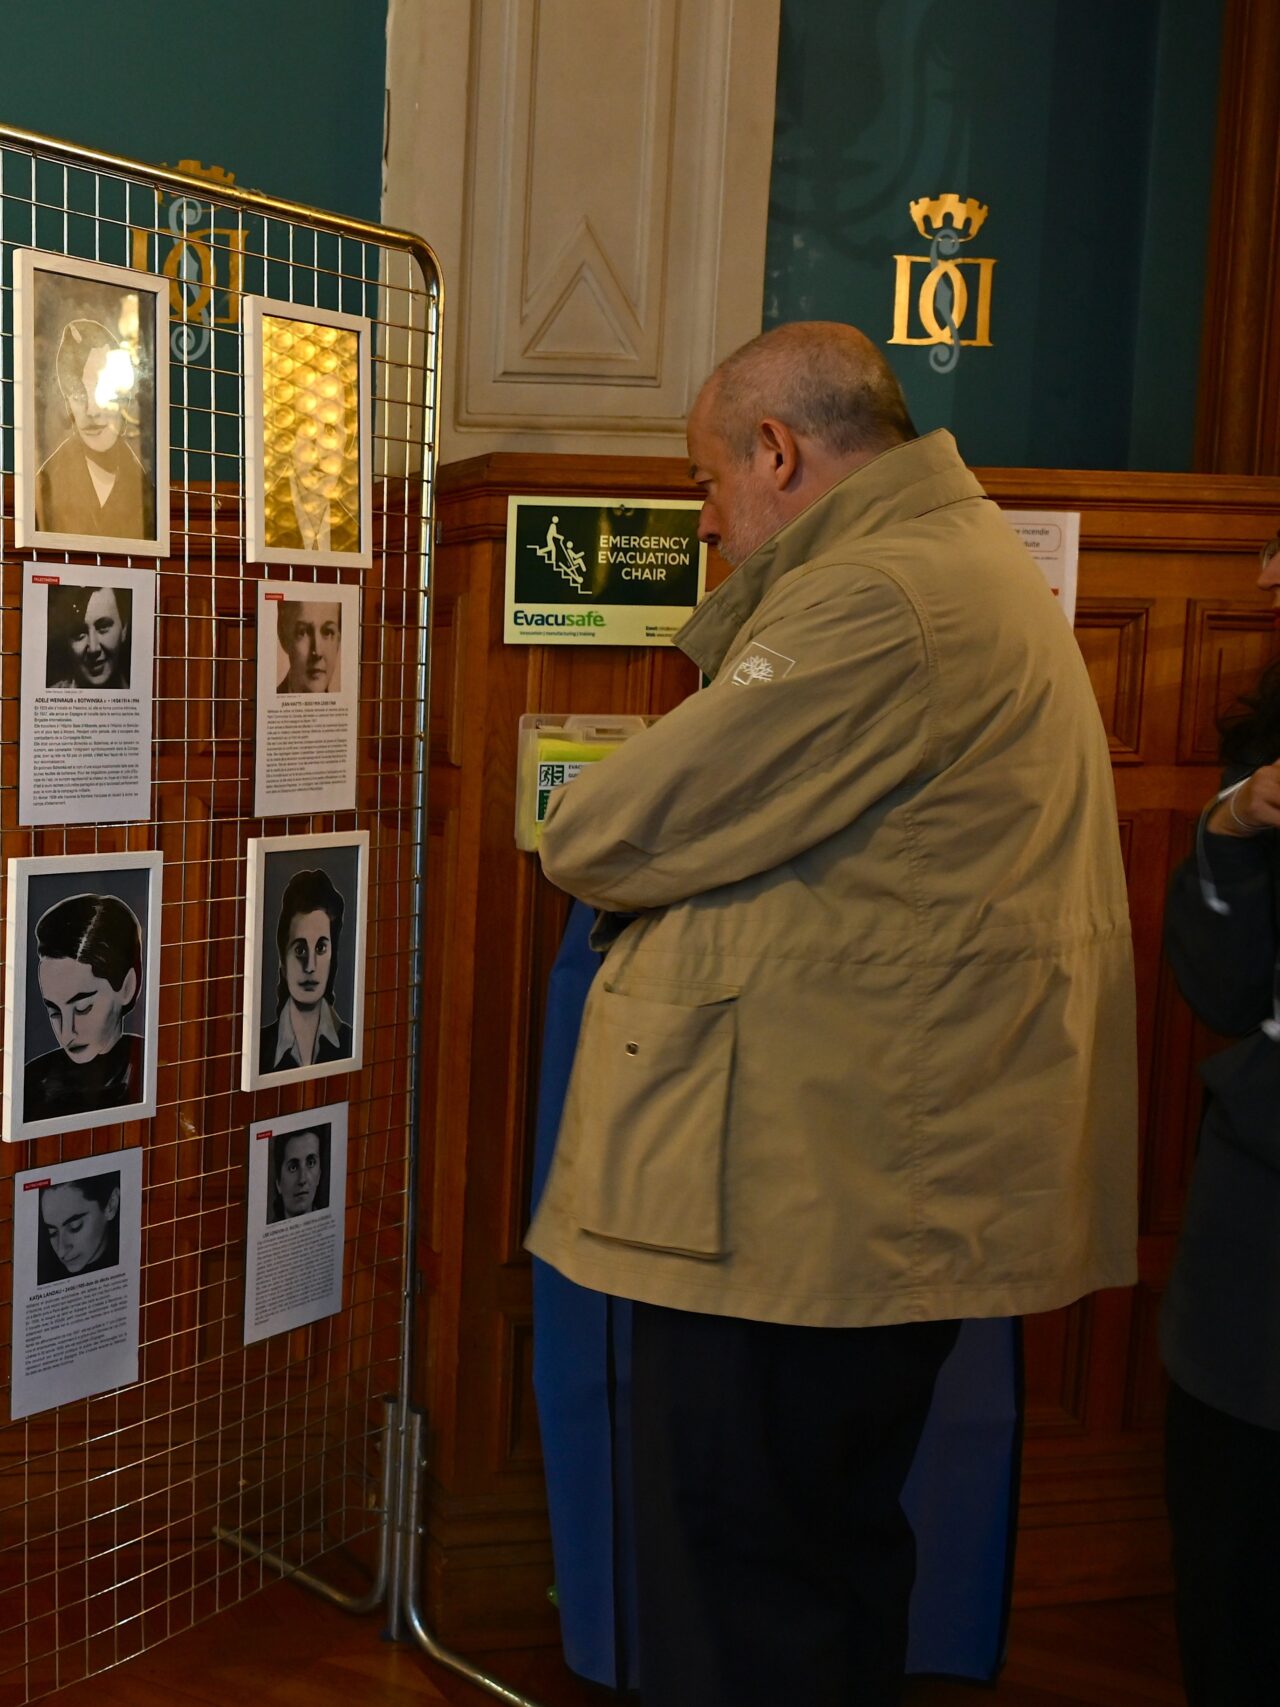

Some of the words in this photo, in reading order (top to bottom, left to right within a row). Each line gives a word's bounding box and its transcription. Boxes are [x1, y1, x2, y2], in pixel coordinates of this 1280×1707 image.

[1022, 528, 1050, 536] incendie
[600, 535, 689, 550] EMERGENCY
[598, 552, 690, 566] EVACUATION
[621, 568, 666, 580] CHAIR
[513, 610, 605, 627] Evacusafe
